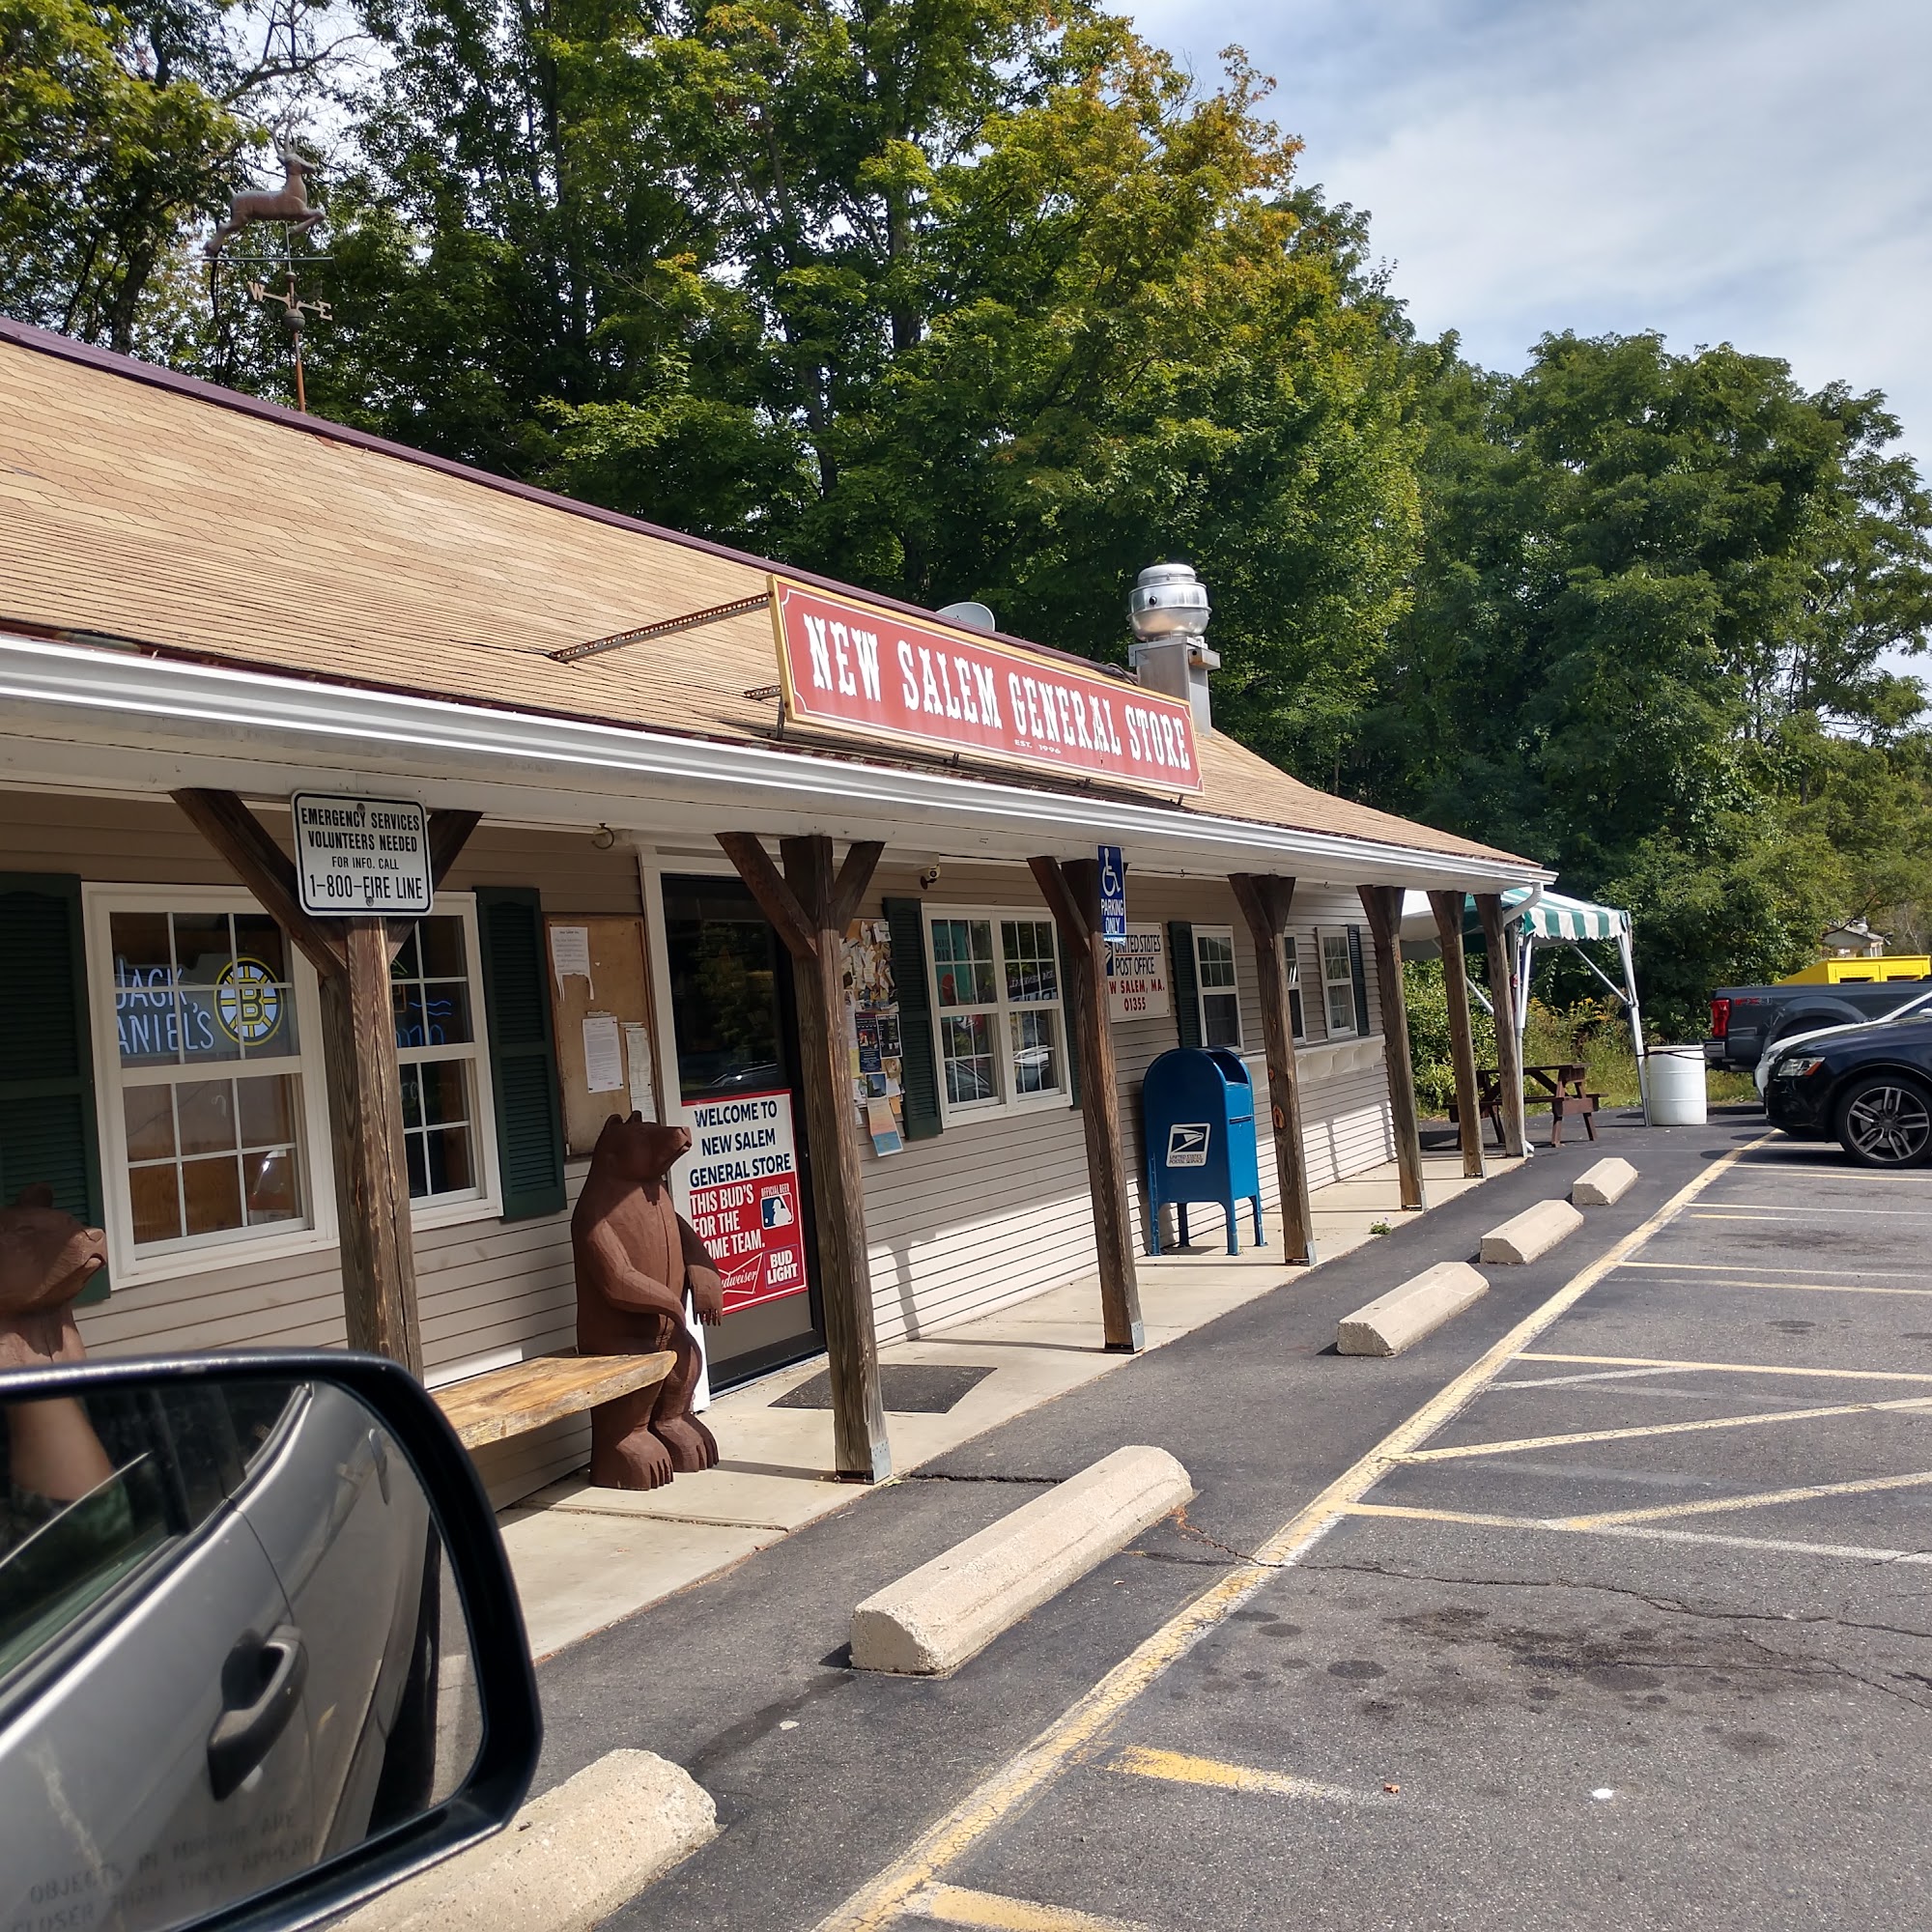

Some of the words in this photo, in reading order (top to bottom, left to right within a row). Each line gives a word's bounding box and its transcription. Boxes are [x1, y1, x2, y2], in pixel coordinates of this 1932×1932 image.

[317, 299, 333, 322] E
[803, 612, 882, 703] NEW
[896, 639, 1003, 730] SALEM
[1008, 670, 1122, 756] GENERAL
[1123, 703, 1191, 771] STORE
[1014, 739, 1033, 749] EST.
[1038, 744, 1062, 754] 1996
[300, 808, 366, 829] EMERGENCY
[371, 812, 420, 832] SERVICES
[308, 830, 375, 851] VOLUNTEERS
[379, 835, 418, 852] NEEDED
[331, 856, 349, 868] FOR
[352, 857, 376, 869] INFO.
[378, 858, 400, 870] CALL
[309, 874, 392, 899] 1-800-FIRE
[395, 876, 423, 899] LINE
[1101, 898, 1124, 917] PARKING
[1105, 917, 1121, 934] ONLY
[1115, 934, 1139, 953] UNITED
[1140, 934, 1161, 952] STATES
[1115, 957, 1132, 977] POST
[1134, 956, 1155, 976] OFFICE
[116, 958, 187, 1009] JACK
[1108, 980, 1117, 995] W
[1121, 980, 1149, 994] SALEM,
[1151, 979, 1165, 992] MA.
[1123, 997, 1147, 1012] 01355
[116, 1003, 215, 1054] ANIEL'S
[695, 1102, 758, 1128] WELCOME
[760, 1100, 778, 1120] TO
[701, 1134, 731, 1157] NEW
[735, 1128, 776, 1151] SALEM
[690, 1160, 751, 1188] GENERAL
[753, 1152, 792, 1178] STORE
[690, 1190, 718, 1216] THIS
[720, 1183, 754, 1210] BUD'S
[693, 1215, 717, 1238] FOR
[717, 1209, 741, 1234] THE
[703, 1236, 730, 1260] OME
[730, 1228, 766, 1255] TEAM.
[770, 1250, 793, 1269] BUD
[766, 1263, 798, 1285] LIGHT
